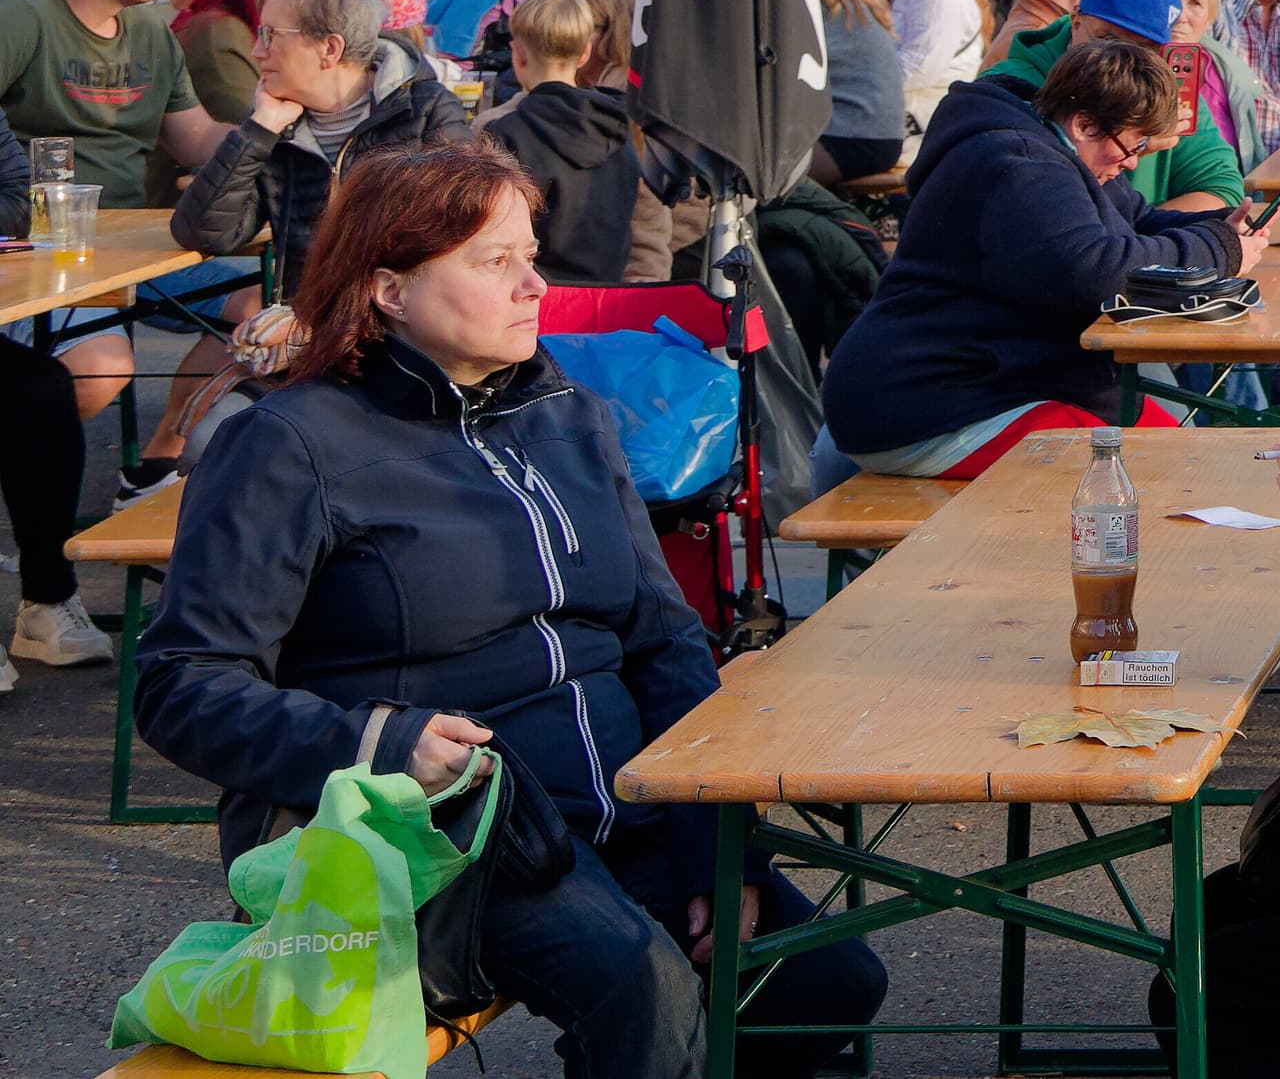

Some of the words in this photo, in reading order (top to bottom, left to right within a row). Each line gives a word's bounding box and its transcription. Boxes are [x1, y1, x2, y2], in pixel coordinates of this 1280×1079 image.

[1128, 663, 1169, 673] Rauchen
[1125, 673, 1137, 682] ist
[1139, 672, 1171, 683] tödlich
